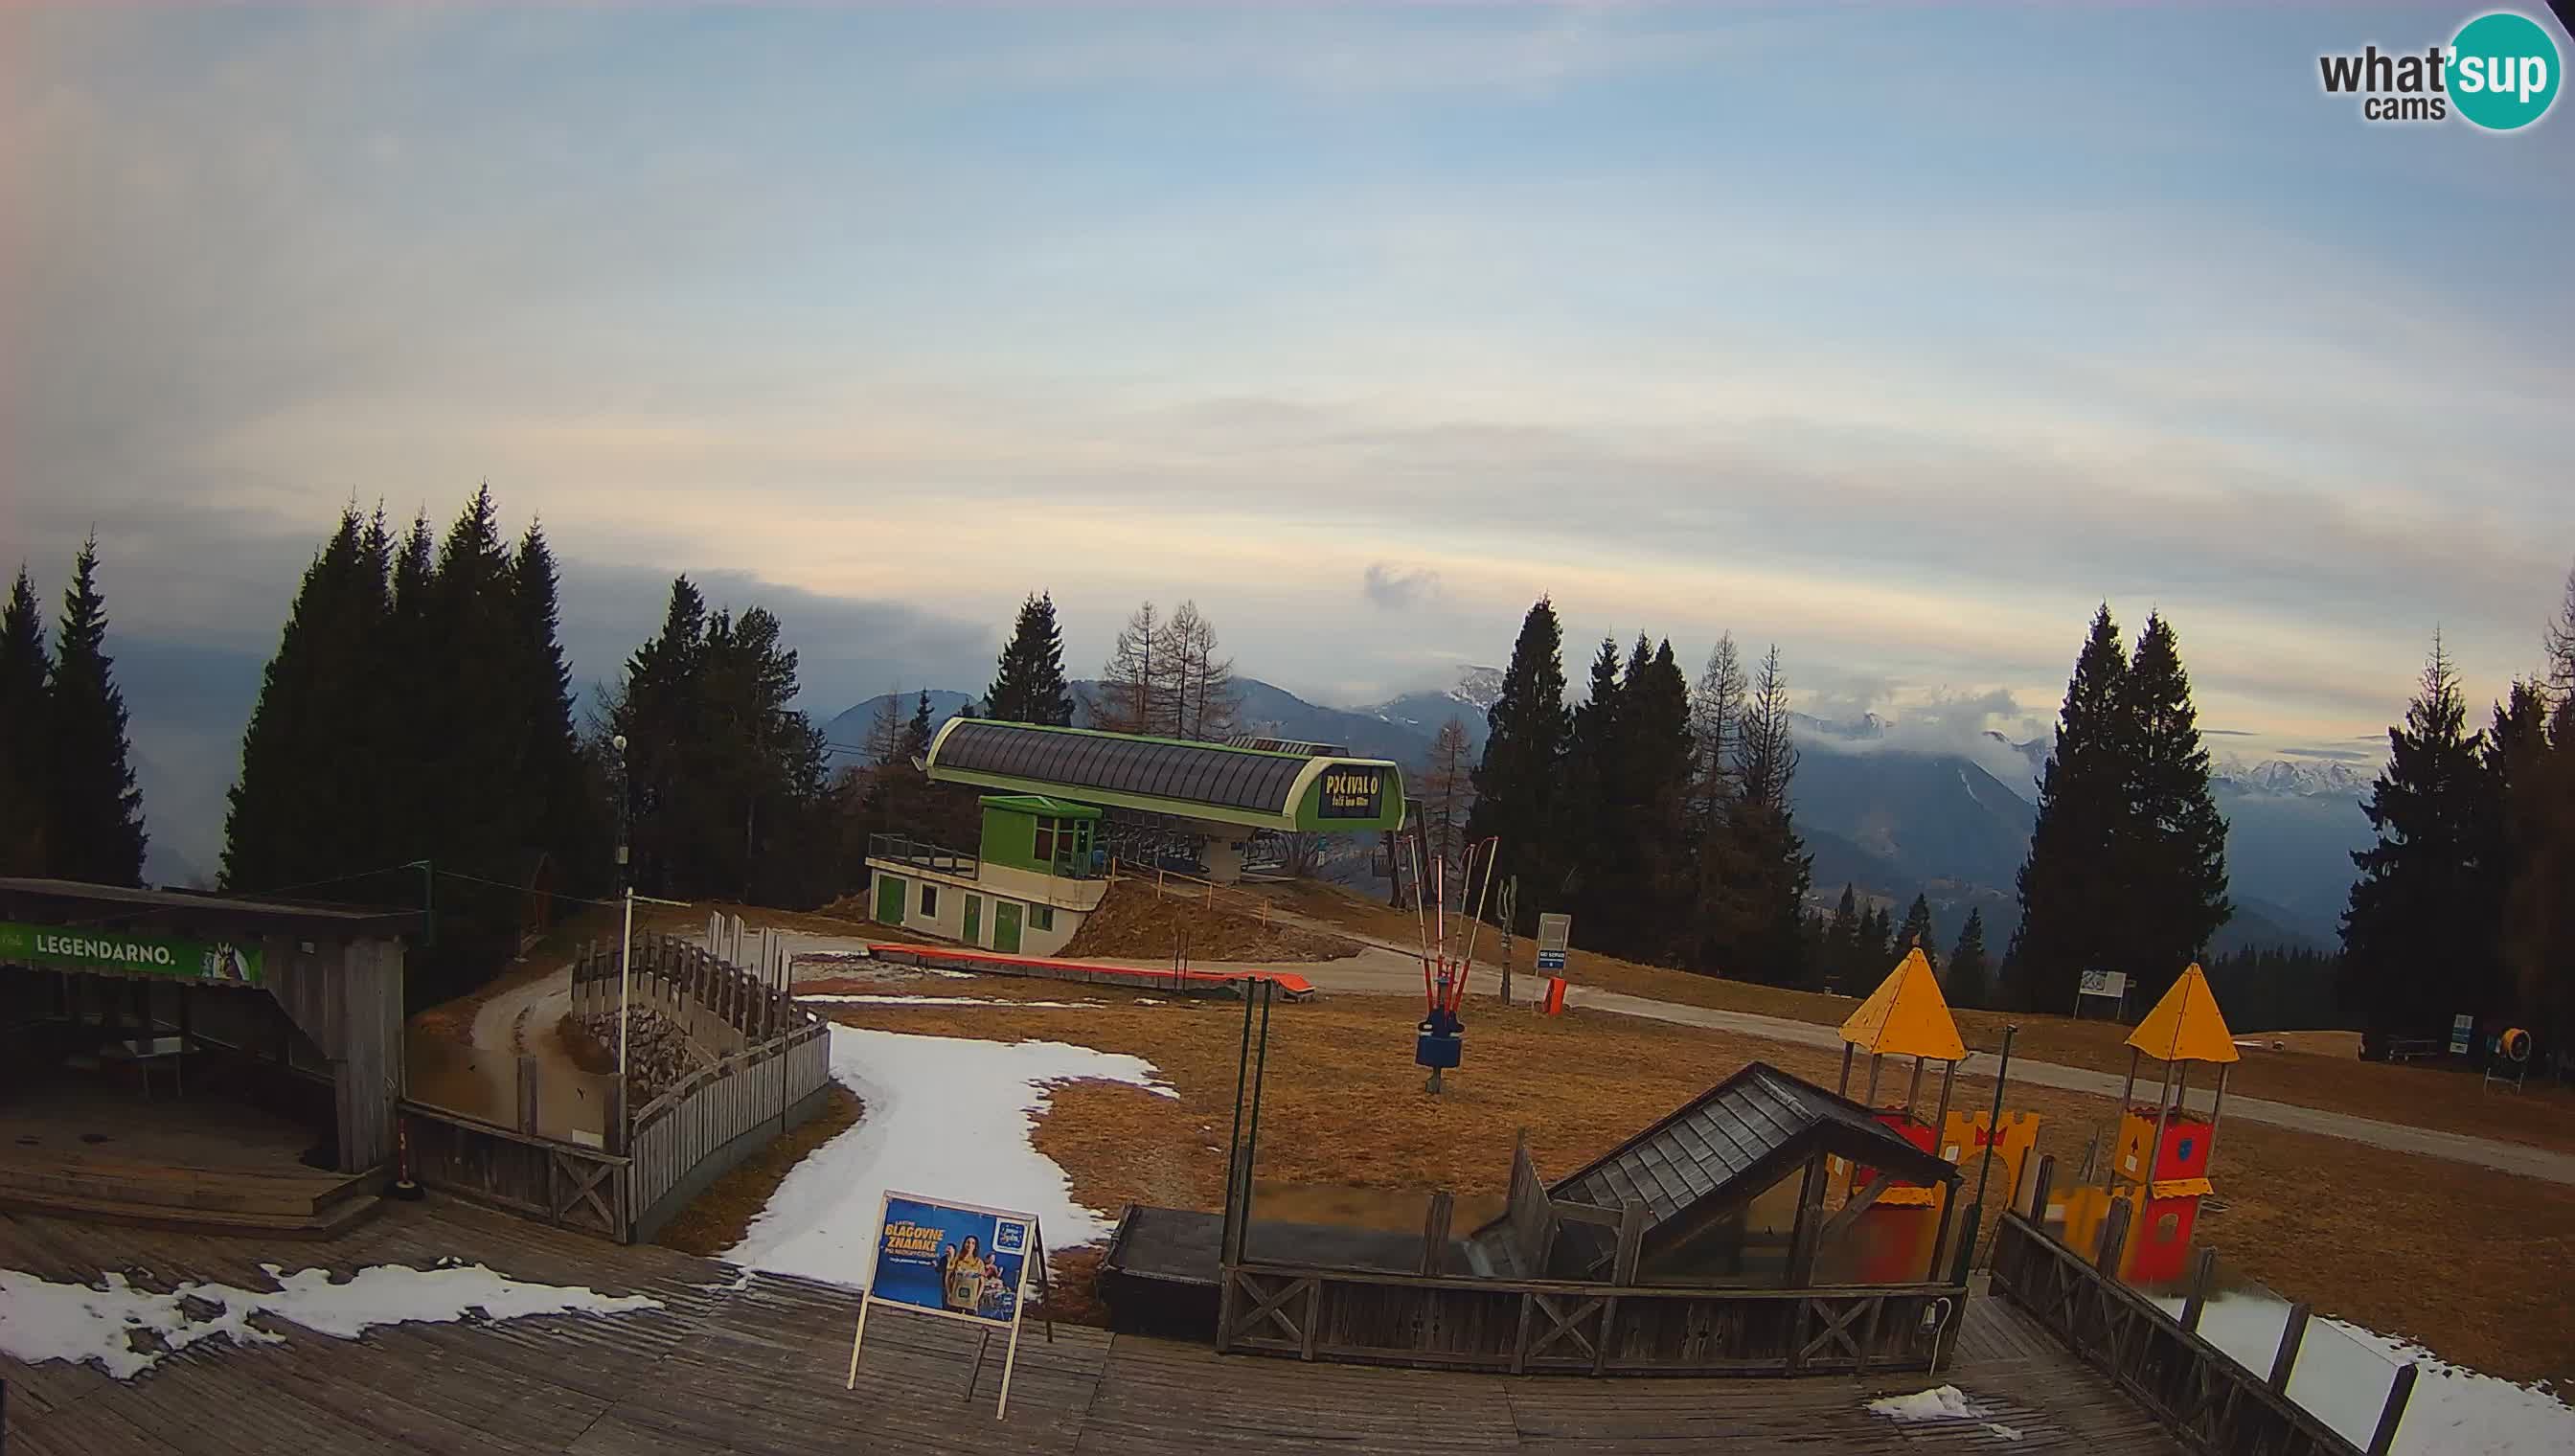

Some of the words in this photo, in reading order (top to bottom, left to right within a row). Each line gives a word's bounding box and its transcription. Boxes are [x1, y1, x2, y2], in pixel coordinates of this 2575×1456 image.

[36, 934, 175, 966] LEGENDARNO.
[884, 1224, 946, 1240] BLAGOVNE
[887, 1236, 939, 1252] ZNAMKE
